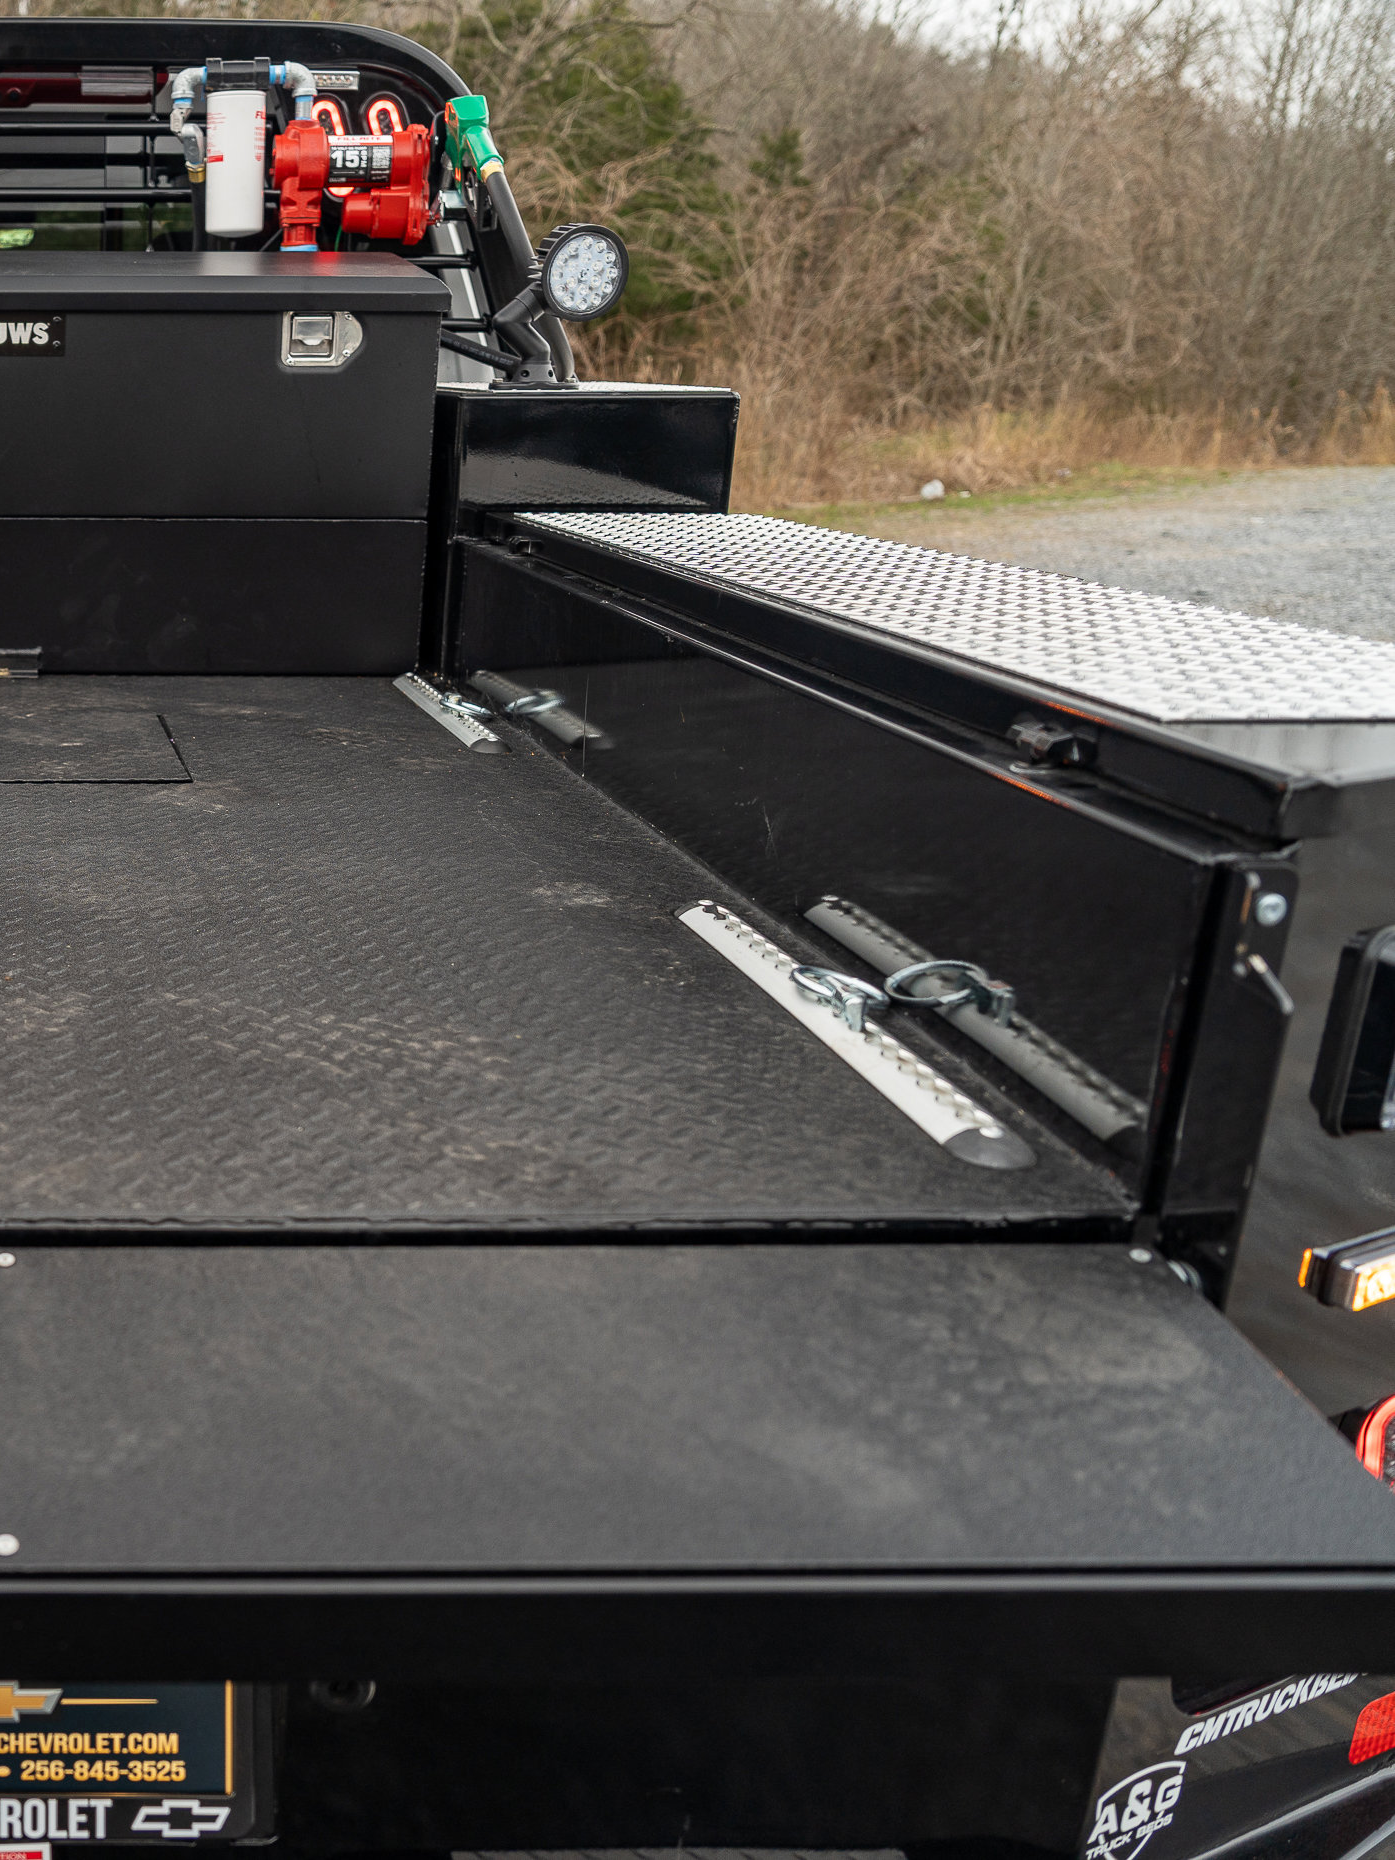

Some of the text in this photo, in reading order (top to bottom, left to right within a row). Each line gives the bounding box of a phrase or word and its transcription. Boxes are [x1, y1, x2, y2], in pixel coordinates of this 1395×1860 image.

[331, 150, 360, 168] 15
[20, 1760, 186, 1782] 256-845-3525
[1086, 1774, 1184, 1845] A&G
[1085, 1812, 1174, 1860] TRUCK BEDS
